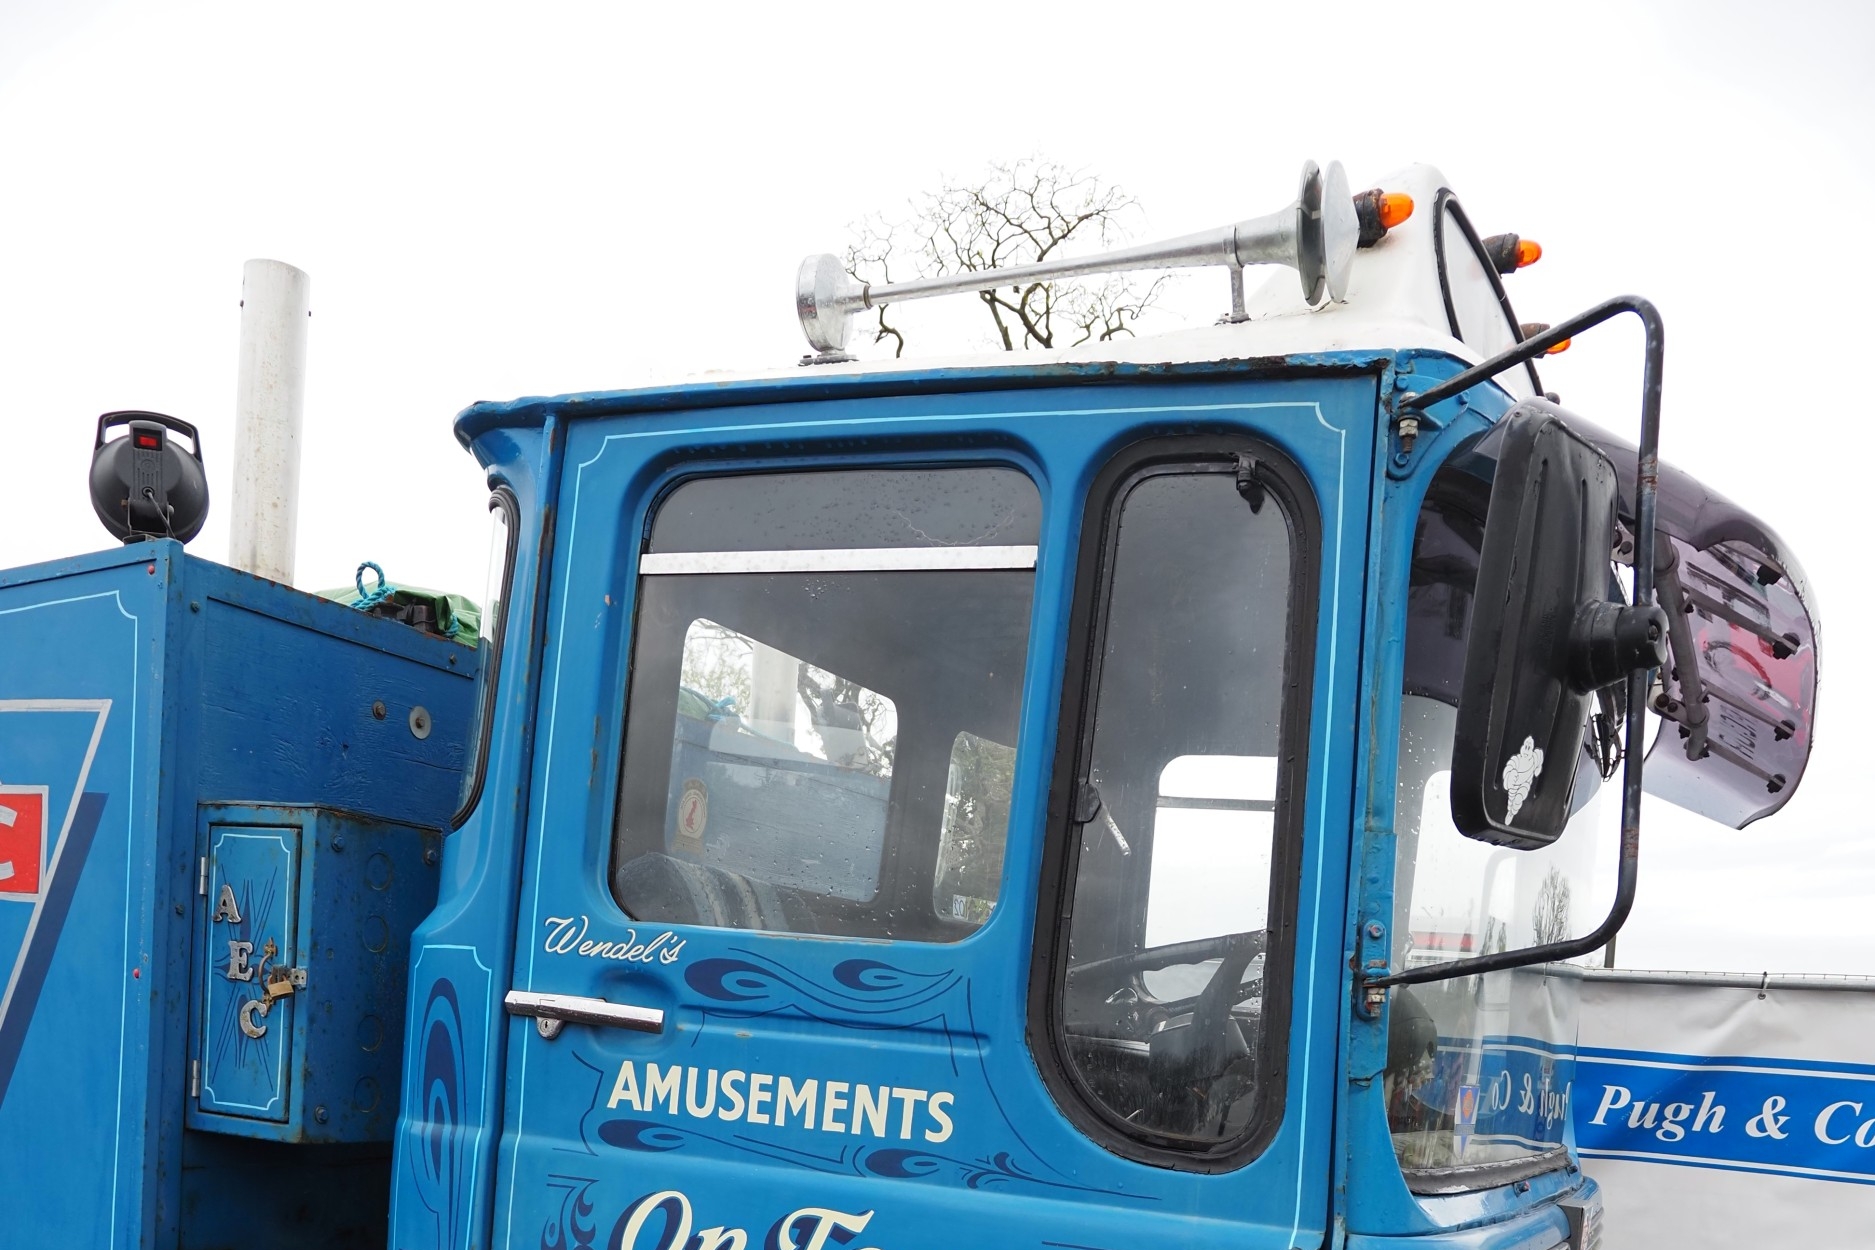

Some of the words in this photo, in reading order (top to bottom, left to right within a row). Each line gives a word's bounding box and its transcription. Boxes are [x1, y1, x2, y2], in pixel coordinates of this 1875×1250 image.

[545, 915, 686, 964] Wendel's
[607, 1060, 956, 1143] AMUSEMENTS
[1588, 1084, 1725, 1142] Pugh
[1744, 1095, 1792, 1140] &
[1814, 1100, 1875, 1148] Co
